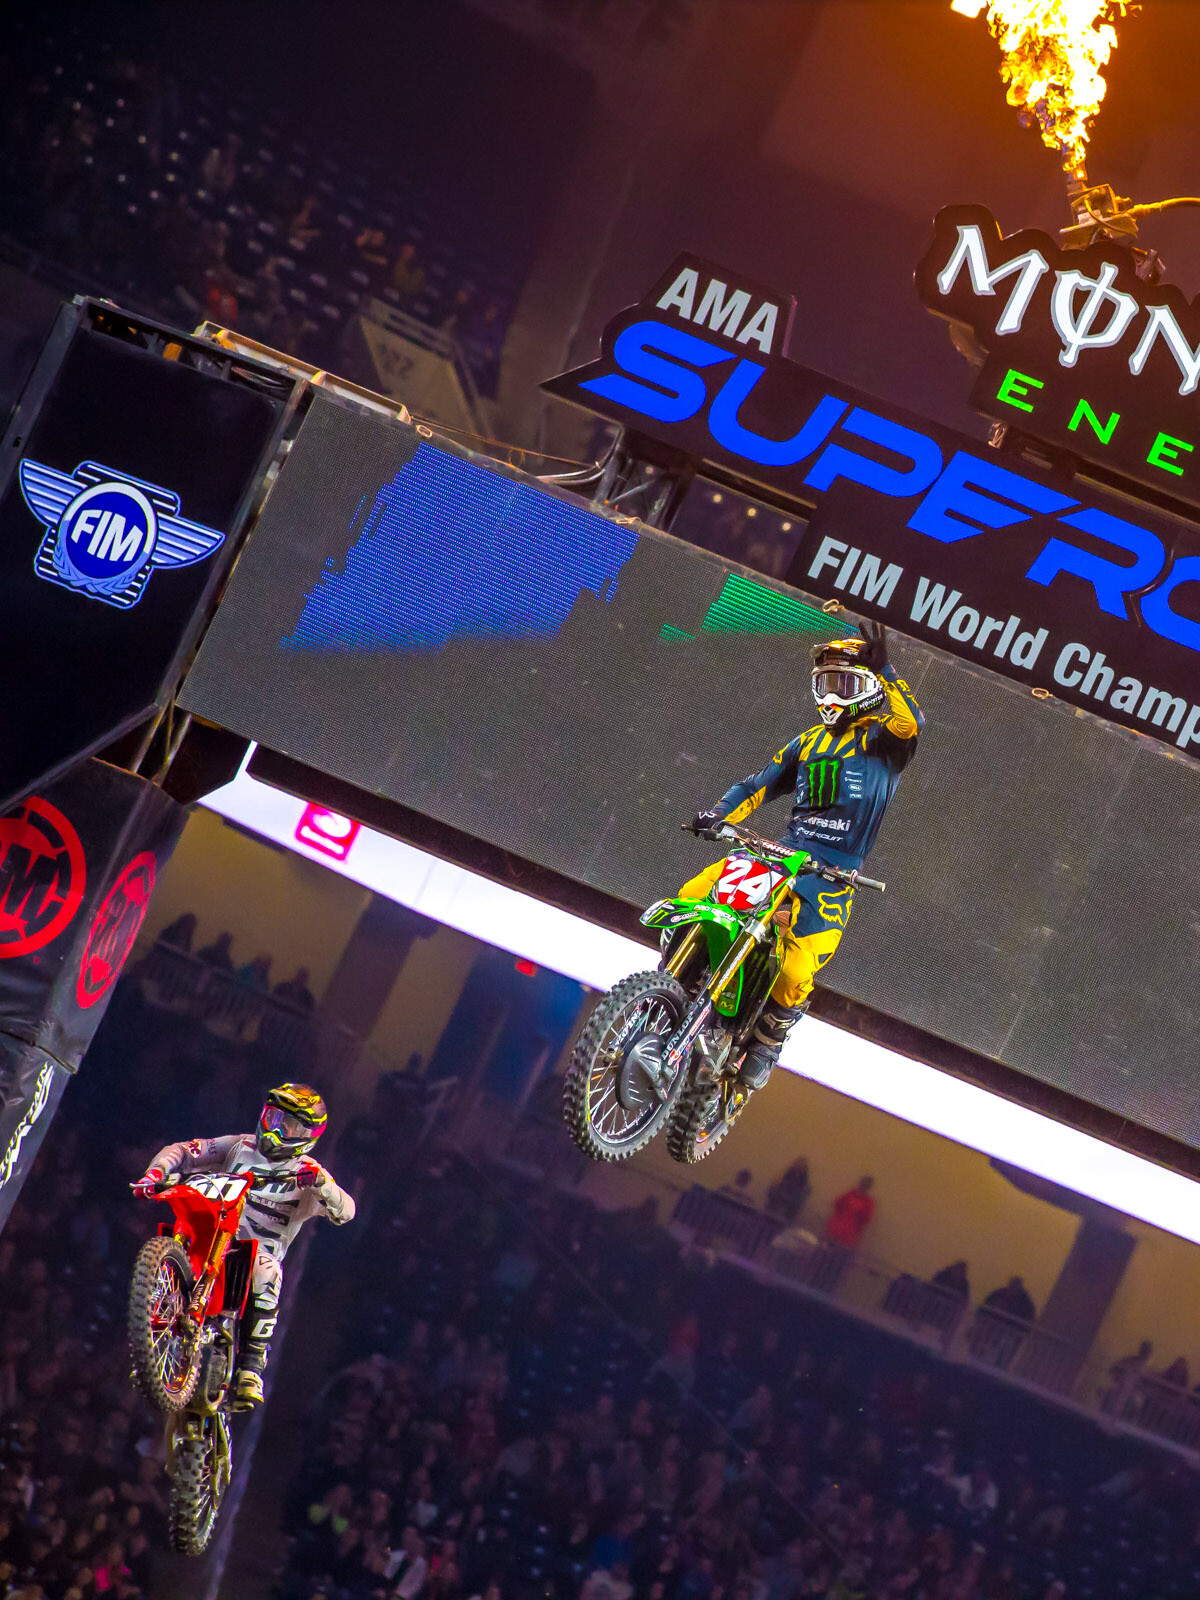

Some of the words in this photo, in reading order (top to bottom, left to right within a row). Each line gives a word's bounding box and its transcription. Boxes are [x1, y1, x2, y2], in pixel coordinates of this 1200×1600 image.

[655, 266, 780, 355] AMA
[70, 509, 144, 563] FIM
[807, 535, 904, 610] FIM
[909, 583, 1050, 672] World
[718, 858, 785, 908] 24
[661, 1011, 695, 1061] DUNLOP
